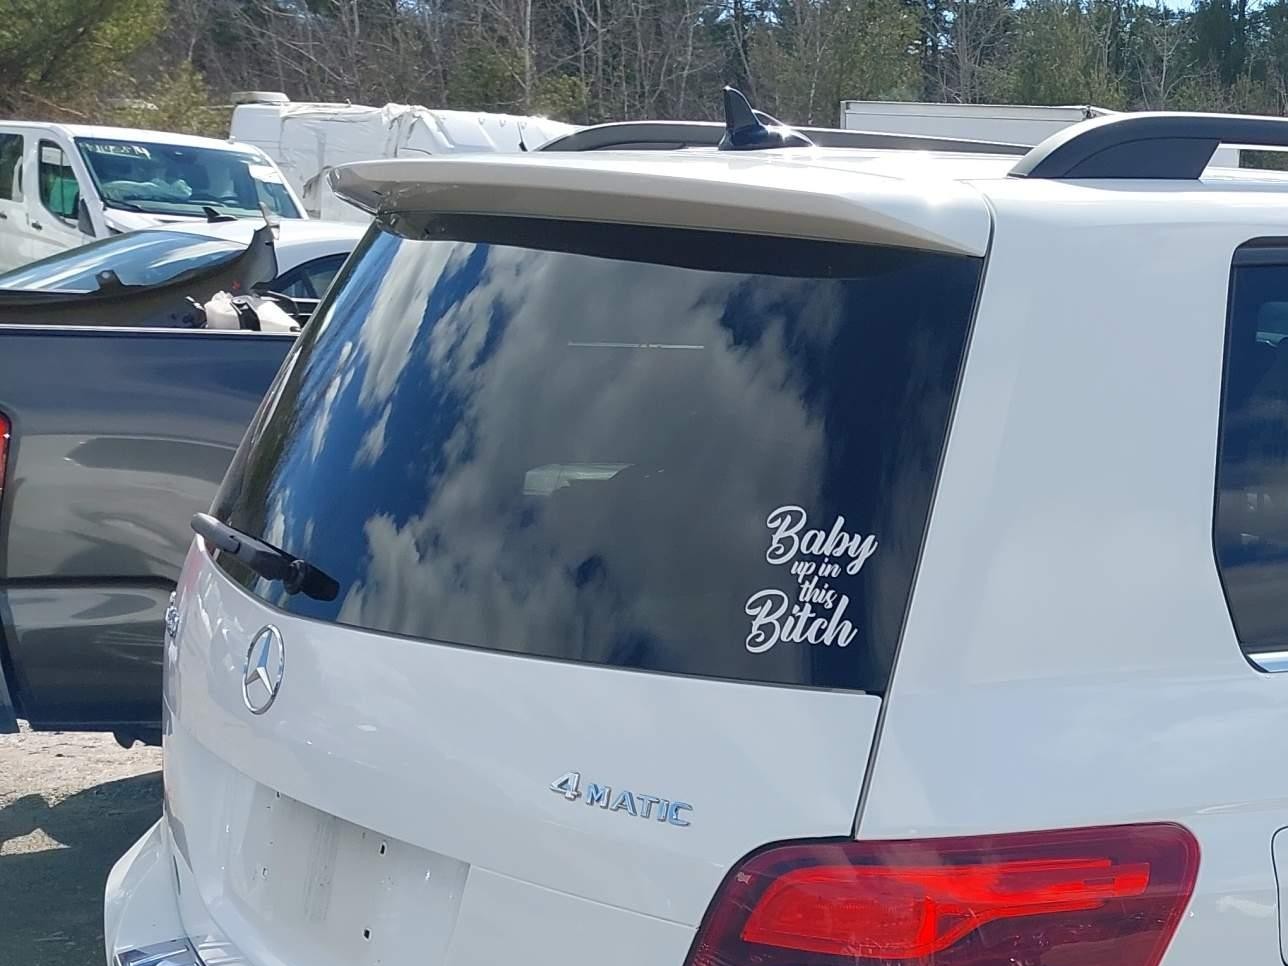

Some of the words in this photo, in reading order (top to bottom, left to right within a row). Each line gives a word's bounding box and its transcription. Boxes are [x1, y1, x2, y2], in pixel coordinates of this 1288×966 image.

[766, 505, 879, 575] Baby
[790, 560, 815, 583] up
[818, 557, 841, 577] in
[799, 575, 837, 609] this
[745, 589, 858, 654] Bitch
